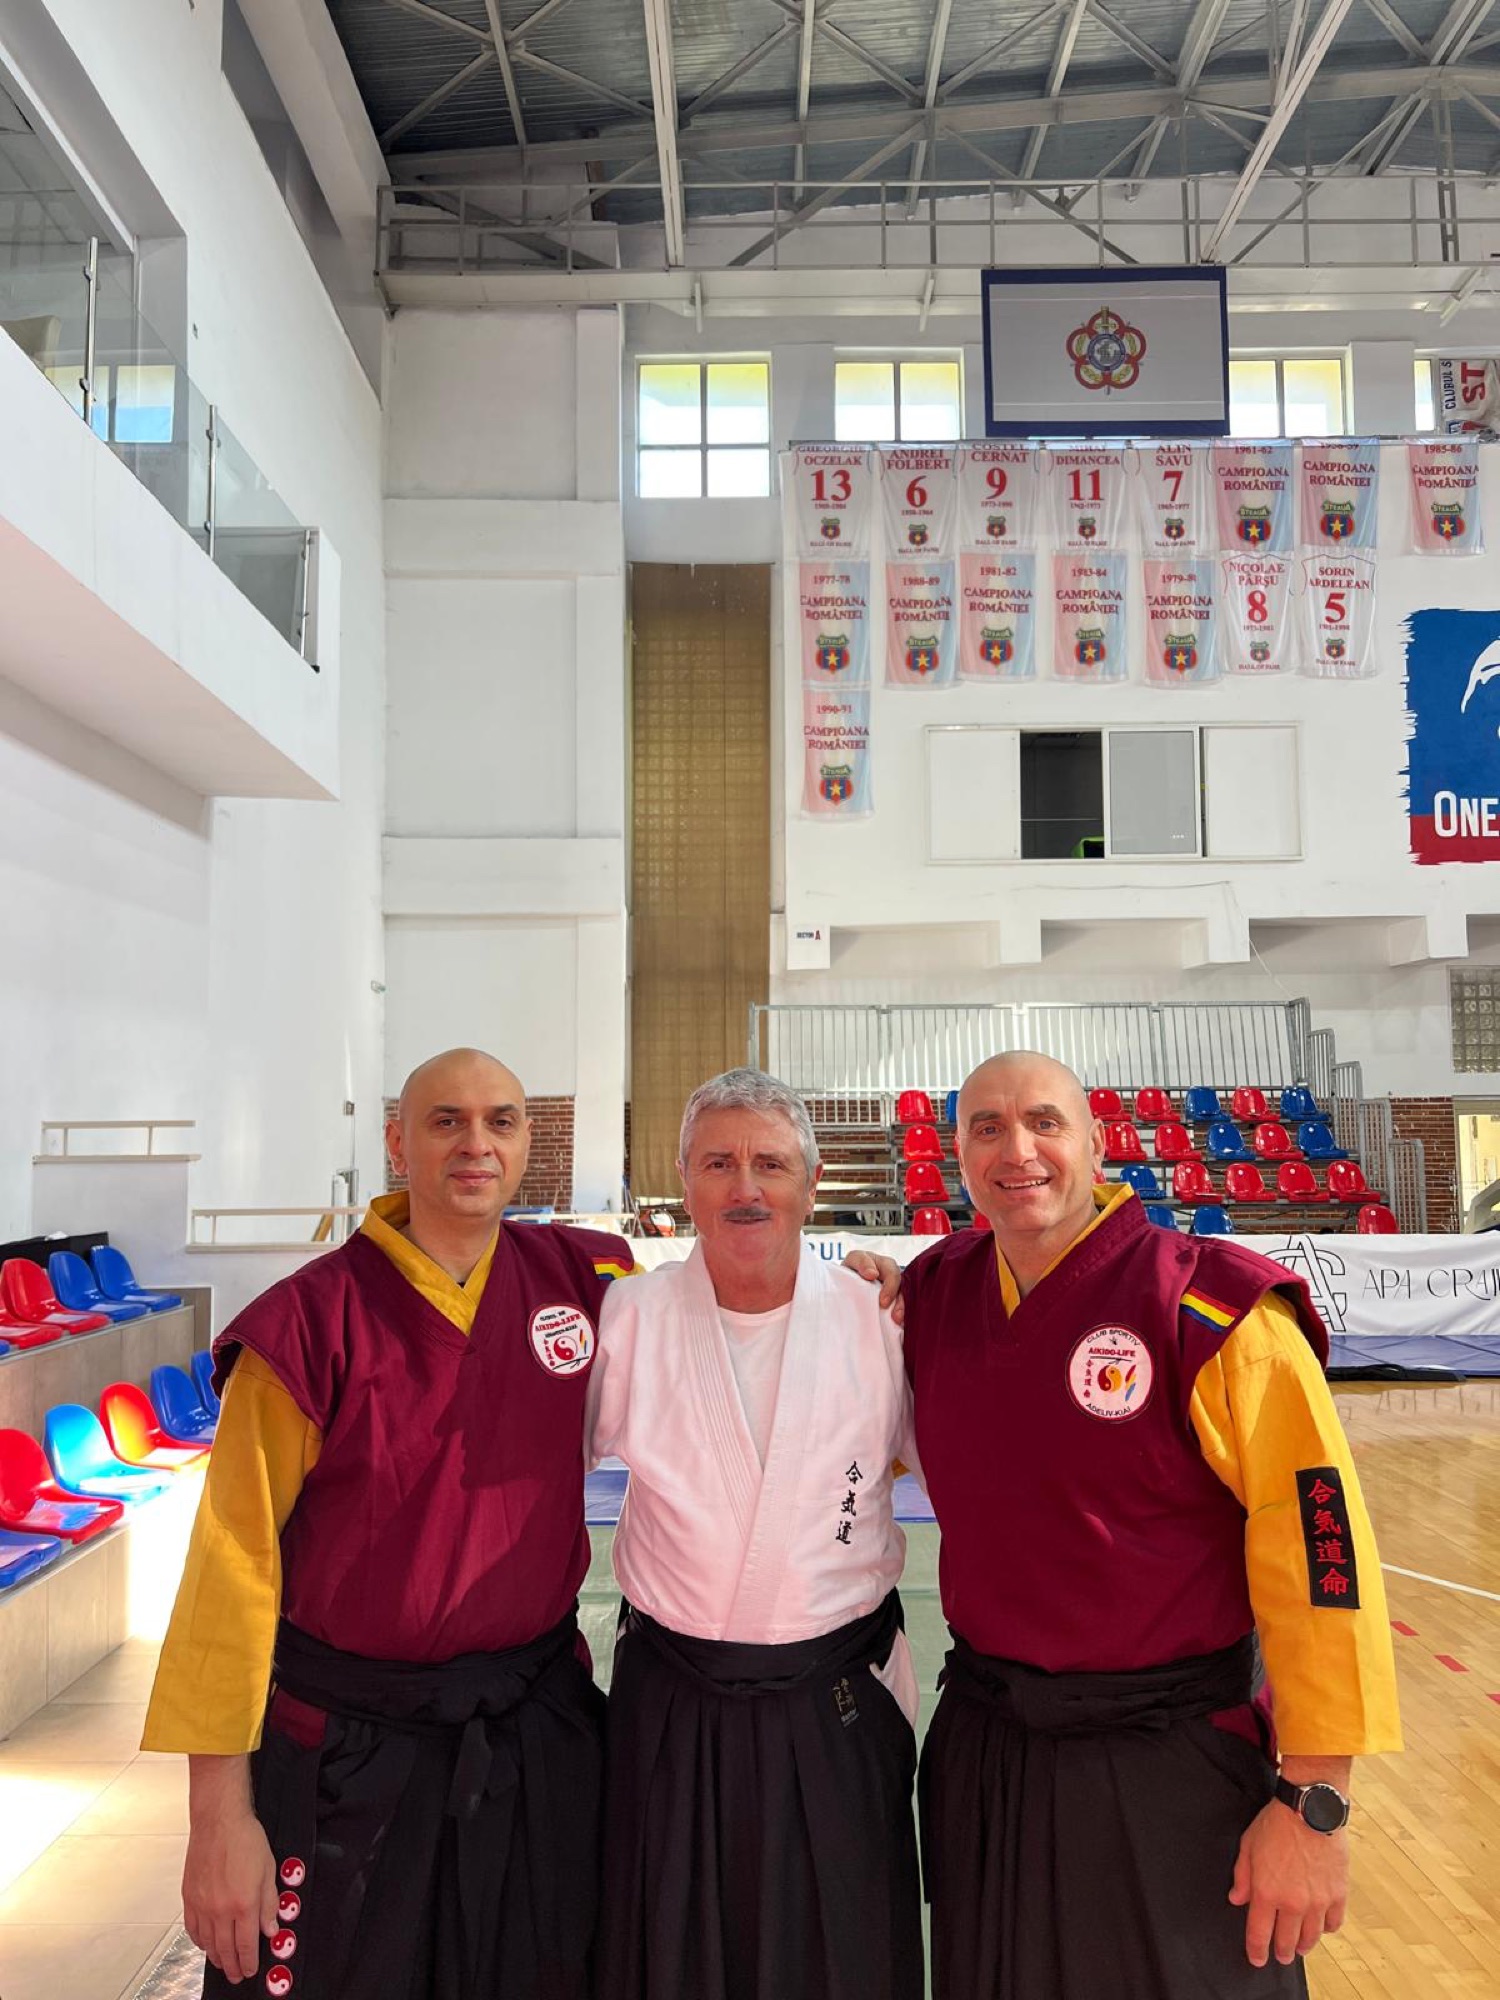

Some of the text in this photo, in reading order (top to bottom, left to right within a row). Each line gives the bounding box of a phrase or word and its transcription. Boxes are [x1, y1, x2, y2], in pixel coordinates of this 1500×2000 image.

[1442, 371, 1456, 410] CLUBUL
[890, 449, 944, 459] ANDREI
[1156, 444, 1191, 454] ALIN
[971, 451, 1029, 463] CERNAT
[1056, 456, 1120, 465] DIMANCEA
[1155, 455, 1192, 466] SAVU
[887, 459, 950, 470] FOLBERT
[1303, 461, 1376, 473] CAMPIOANA
[1218, 467, 1289, 477] CAMPIOANA
[810, 469, 852, 501] 13
[986, 466, 1007, 499] 9
[1067, 469, 1105, 501] 11
[1163, 470, 1184, 502] 7
[1224, 480, 1285, 490] ROMÂNIEI
[1309, 475, 1371, 487] ROMÂNIEI
[906, 475, 927, 508] 6
[1230, 561, 1285, 573] NICOLAE
[1319, 566, 1355, 576] SORIN
[964, 588, 1032, 599] CAMPIOANA
[1056, 590, 1123, 600] CAMPIOANA
[889, 596, 951, 609] CAMPIOAN
[969, 601, 1029, 613] ROMÂNIEI
[1062, 601, 1119, 614] ROMÂNIEI
[1247, 589, 1268, 623] 8
[1325, 592, 1346, 624] 5
[1150, 608, 1210, 620] ROMÂNIEI
[803, 725, 870, 737] CAMPIOANA
[808, 738, 866, 750] ROMÂNIEI
[1434, 790, 1499, 838] ONE
[815, 929, 821, 940] A
[808, 1241, 847, 1261] UL
[1427, 1268, 1500, 1301] CRAI
[1089, 1347, 1136, 1357] AIKIDO-LIFE
